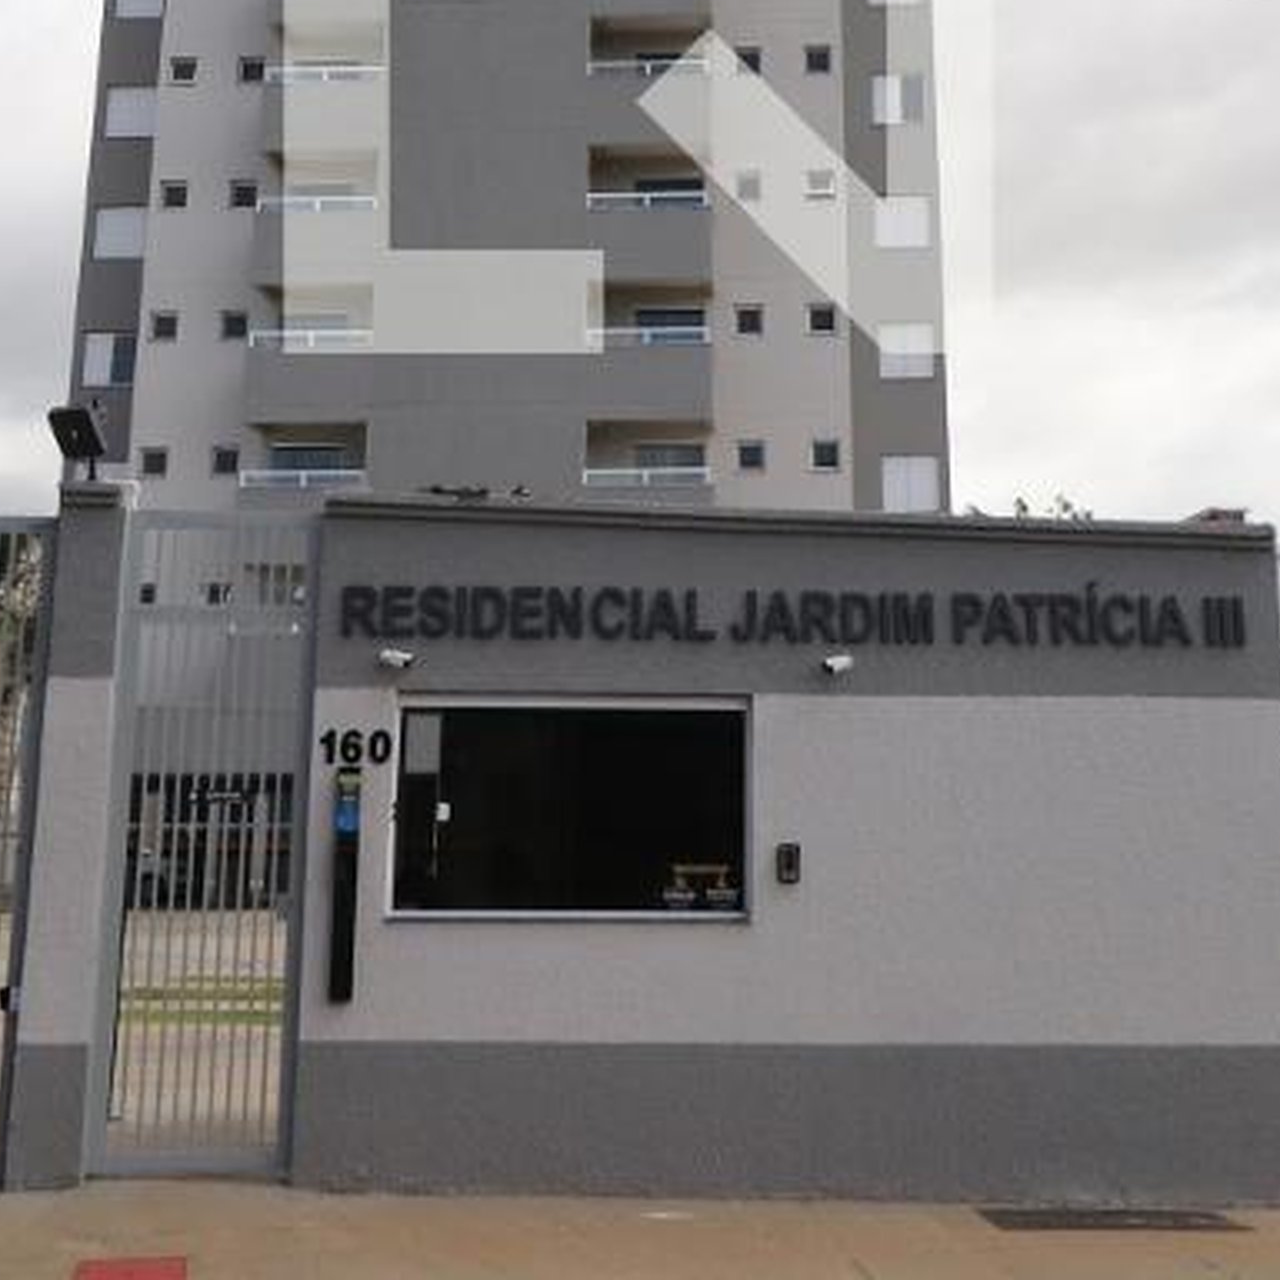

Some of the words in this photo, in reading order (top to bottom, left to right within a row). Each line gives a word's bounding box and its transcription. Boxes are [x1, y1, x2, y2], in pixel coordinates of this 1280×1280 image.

[339, 585, 717, 642] RESIDENCIAL
[730, 588, 934, 646] JARDIM
[950, 580, 1192, 648] PATRÍCIA
[1200, 595, 1246, 649] III
[319, 728, 393, 765] 160
